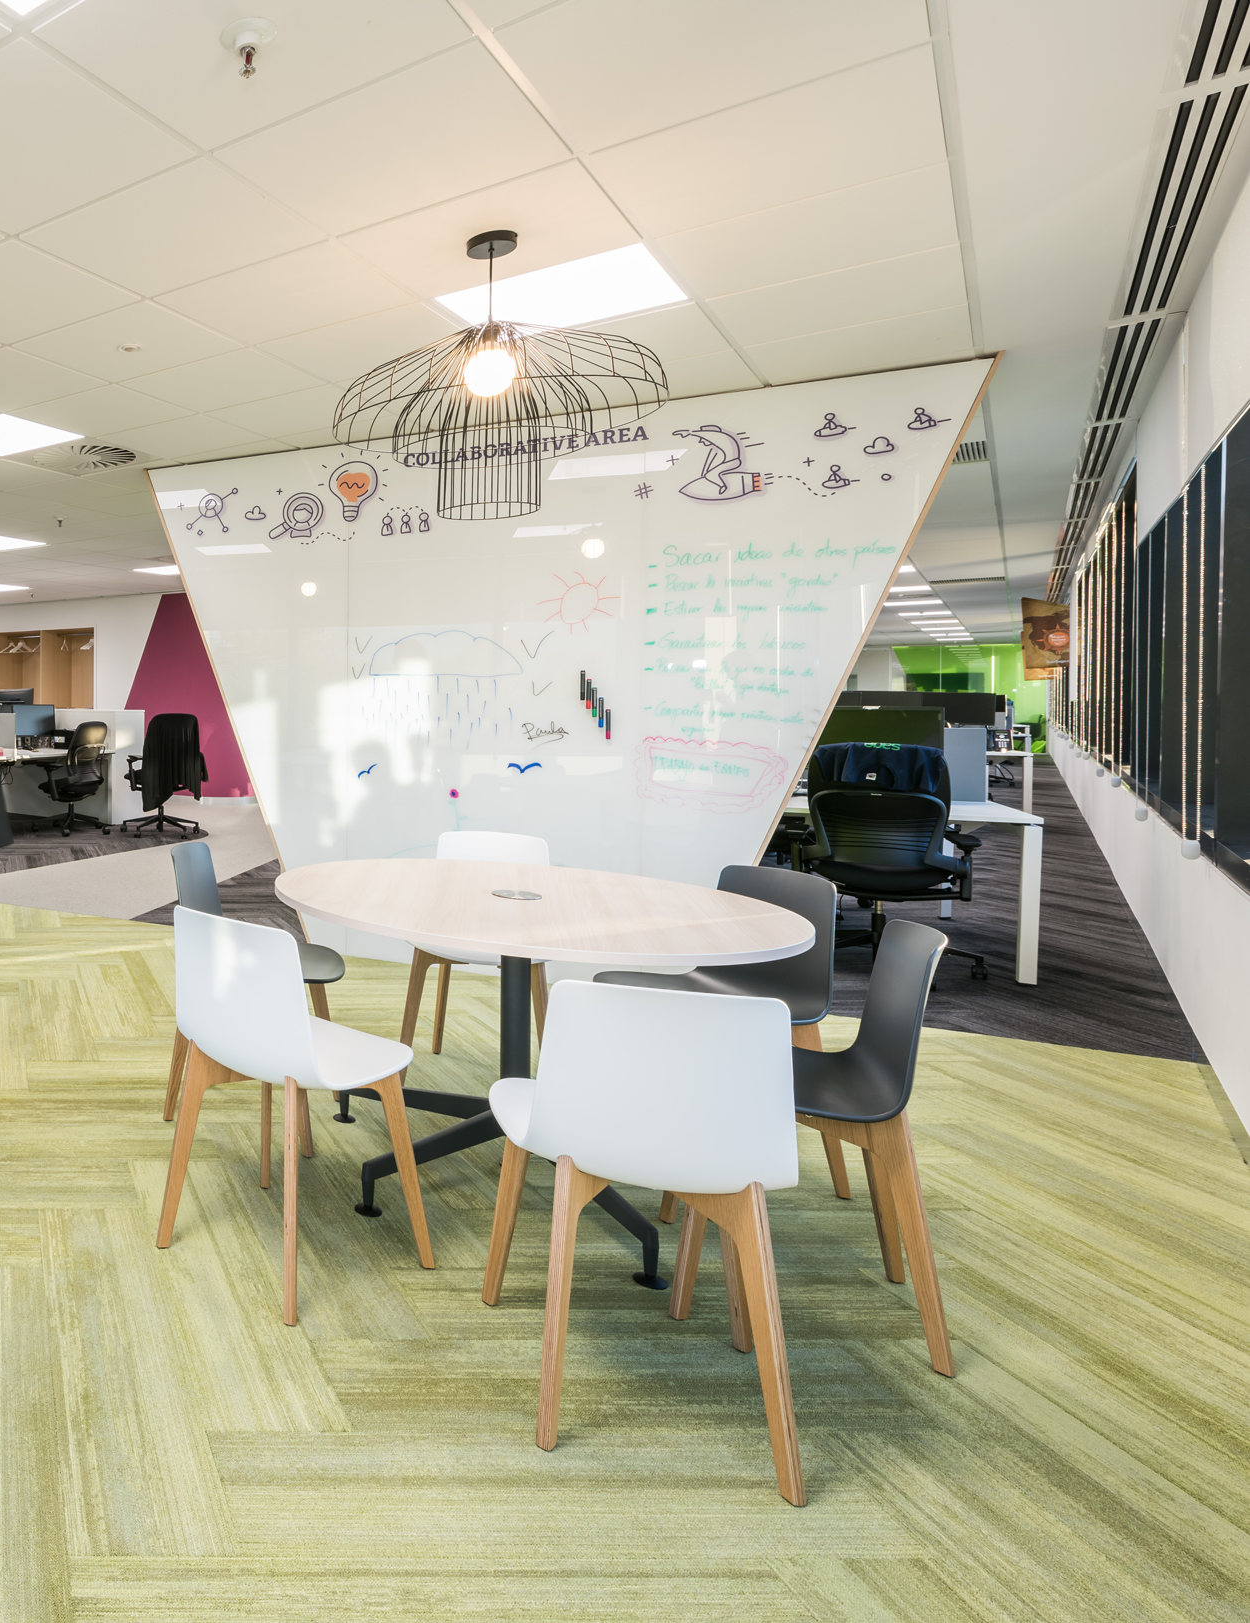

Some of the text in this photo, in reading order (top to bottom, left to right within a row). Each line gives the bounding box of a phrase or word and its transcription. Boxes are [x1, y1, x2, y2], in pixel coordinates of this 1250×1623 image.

[403, 425, 649, 468] COLLABORATIVE AREA
[662, 545, 723, 567] Sacar
[782, 541, 805, 558] de
[815, 538, 848, 558] otros
